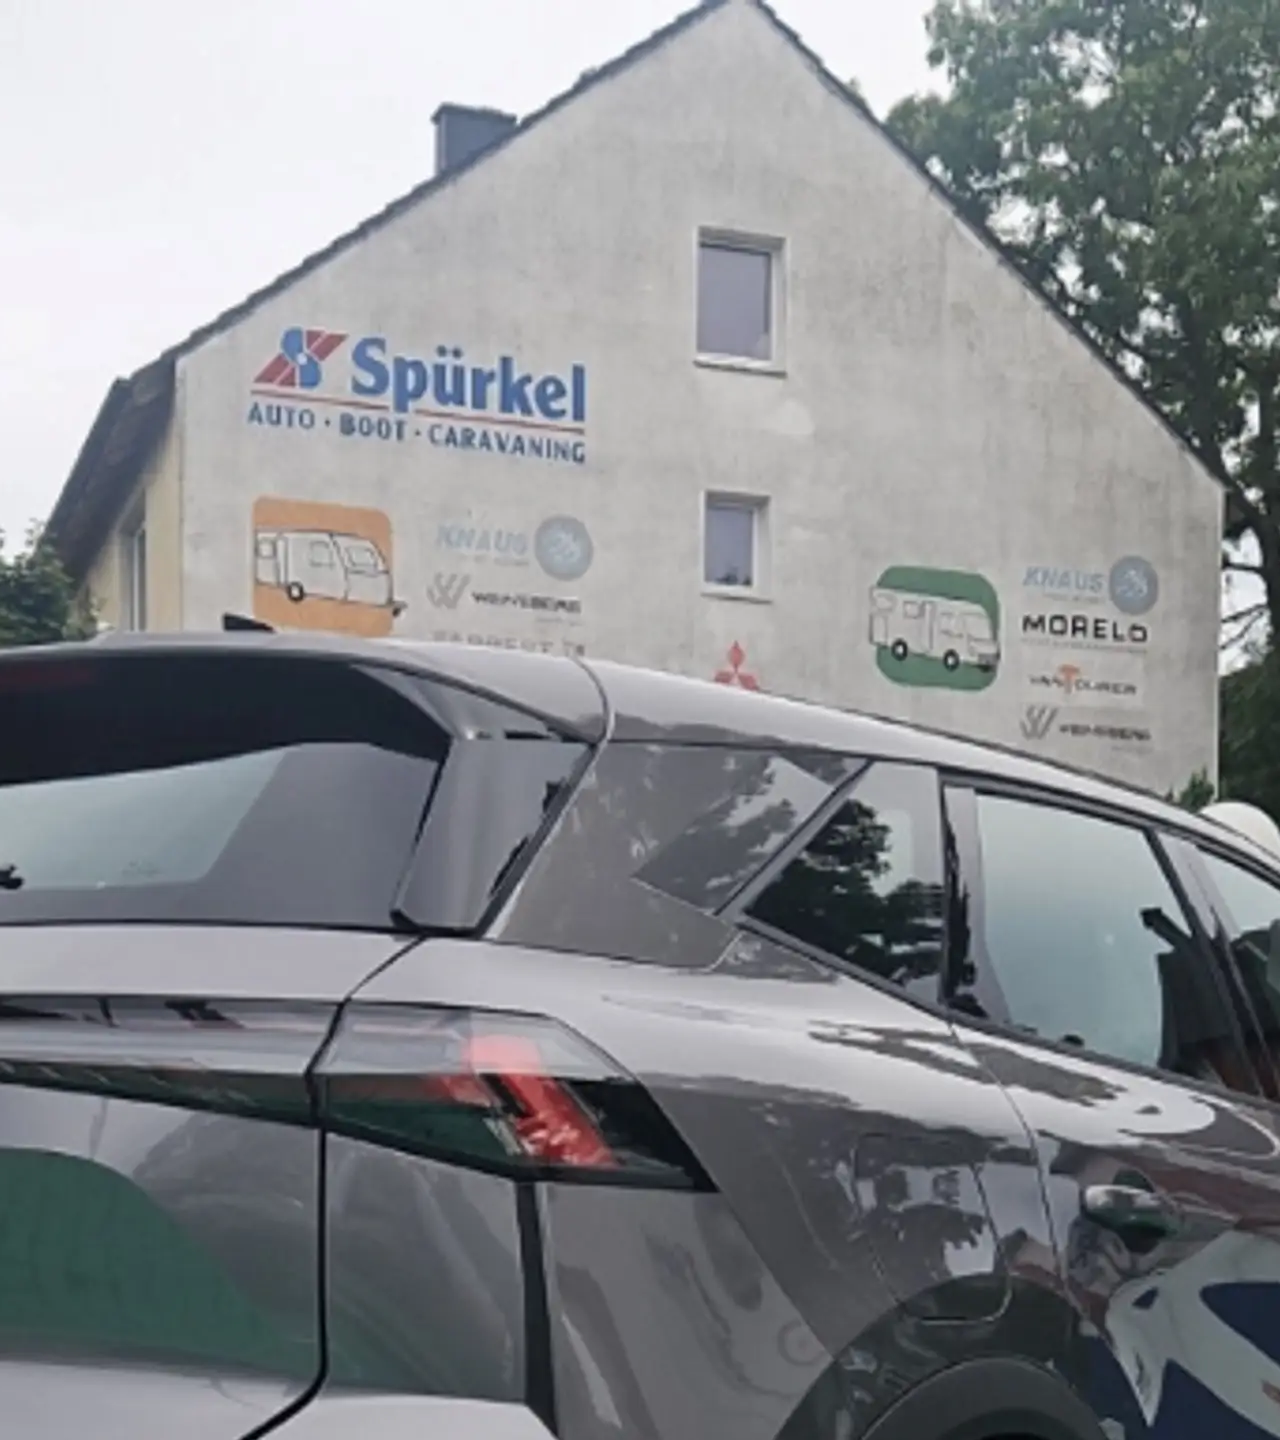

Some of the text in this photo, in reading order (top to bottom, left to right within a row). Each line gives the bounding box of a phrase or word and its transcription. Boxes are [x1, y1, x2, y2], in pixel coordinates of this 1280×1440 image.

[351, 336, 586, 422] Spürkel
[247, 402, 586, 464] AUTO BOOT CARAVANING
[1022, 566, 1103, 592] KNAUS
[1022, 614, 1148, 643] MORELO
